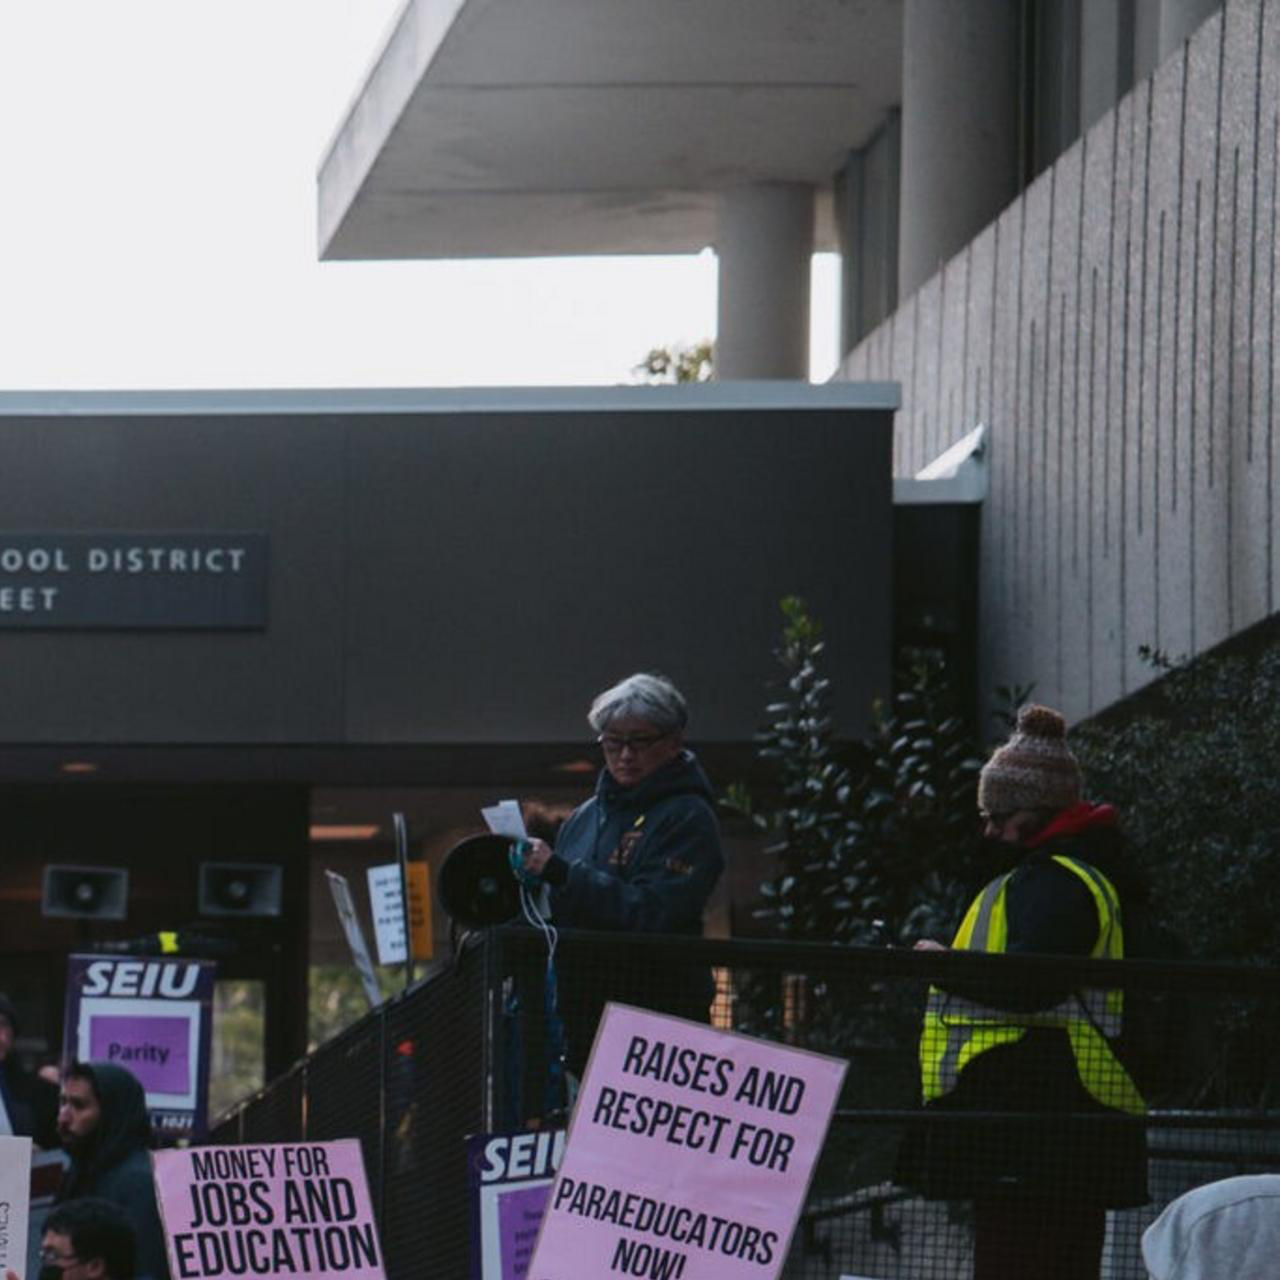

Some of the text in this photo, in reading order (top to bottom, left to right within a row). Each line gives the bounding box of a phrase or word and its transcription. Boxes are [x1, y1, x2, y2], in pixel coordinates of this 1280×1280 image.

[88, 547, 247, 573] DISTRICT
[82, 961, 200, 998] SEIU
[109, 1042, 170, 1067] Parity
[622, 1036, 806, 1116] RAISES AND
[592, 1087, 796, 1173] RESPECT FOR
[190, 1147, 330, 1180] MONEY FOR
[190, 1178, 357, 1229] JOBS AND
[554, 1177, 779, 1267] PARAEDUCATORS
[173, 1223, 379, 1279] EDUCATION
